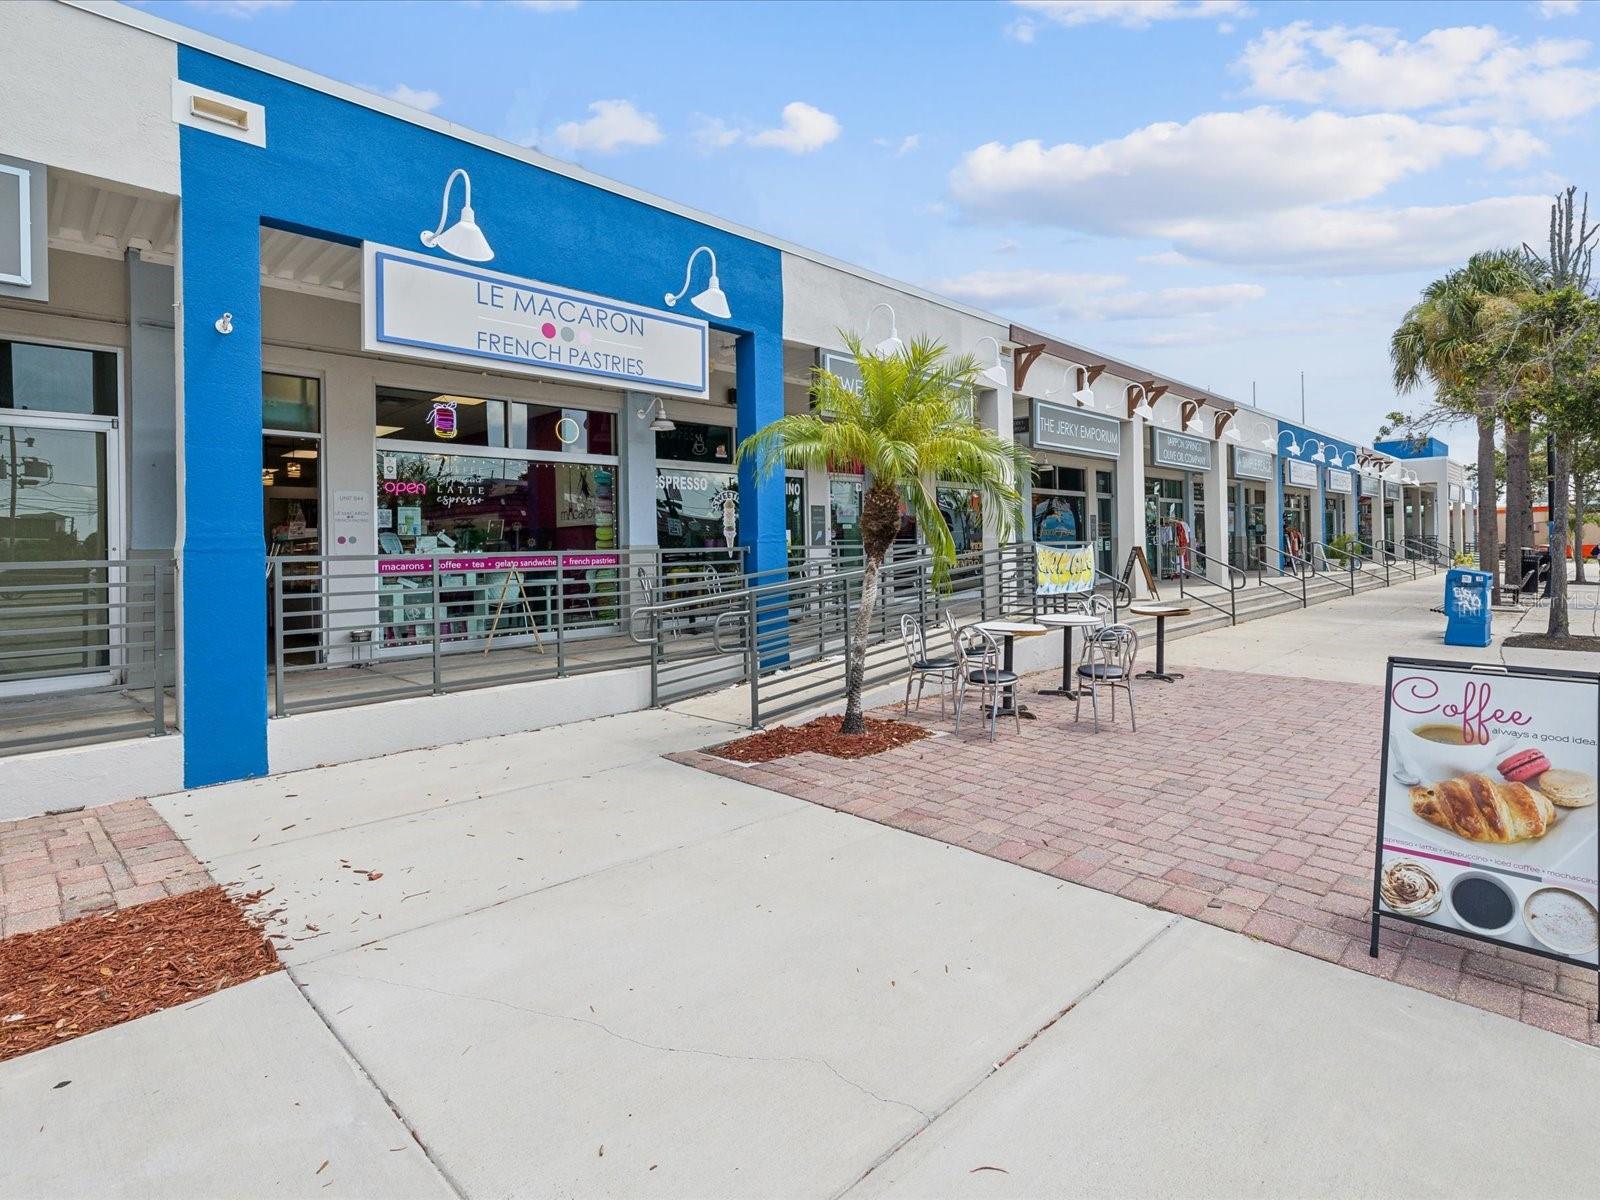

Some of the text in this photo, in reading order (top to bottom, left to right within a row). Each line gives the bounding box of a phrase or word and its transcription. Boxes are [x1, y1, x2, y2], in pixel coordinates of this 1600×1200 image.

[477, 282, 644, 337] LE MACARON
[477, 331, 644, 376] FRENCH PASTRIES
[1040, 417, 1055, 433] THE
[1057, 421, 1079, 438] JERKY
[1080, 425, 1118, 444] EMPORIUM
[384, 482, 427, 496] open
[437, 486, 485, 495] LATTE
[437, 495, 484, 508] espresso
[381, 563, 425, 571] macarons
[438, 560, 462, 569] offee
[520, 557, 557, 566] sandwiche
[569, 557, 590, 565] french
[591, 557, 616, 567] pastries
[1392, 676, 1532, 745] Coffee
[1491, 727, 1530, 739] always
[1540, 734, 1570, 742] good
[1384, 837, 1413, 847] spresso
[1419, 843, 1438, 852] latte
[1494, 857, 1512, 868] iced
[1513, 863, 1540, 873] coffee
